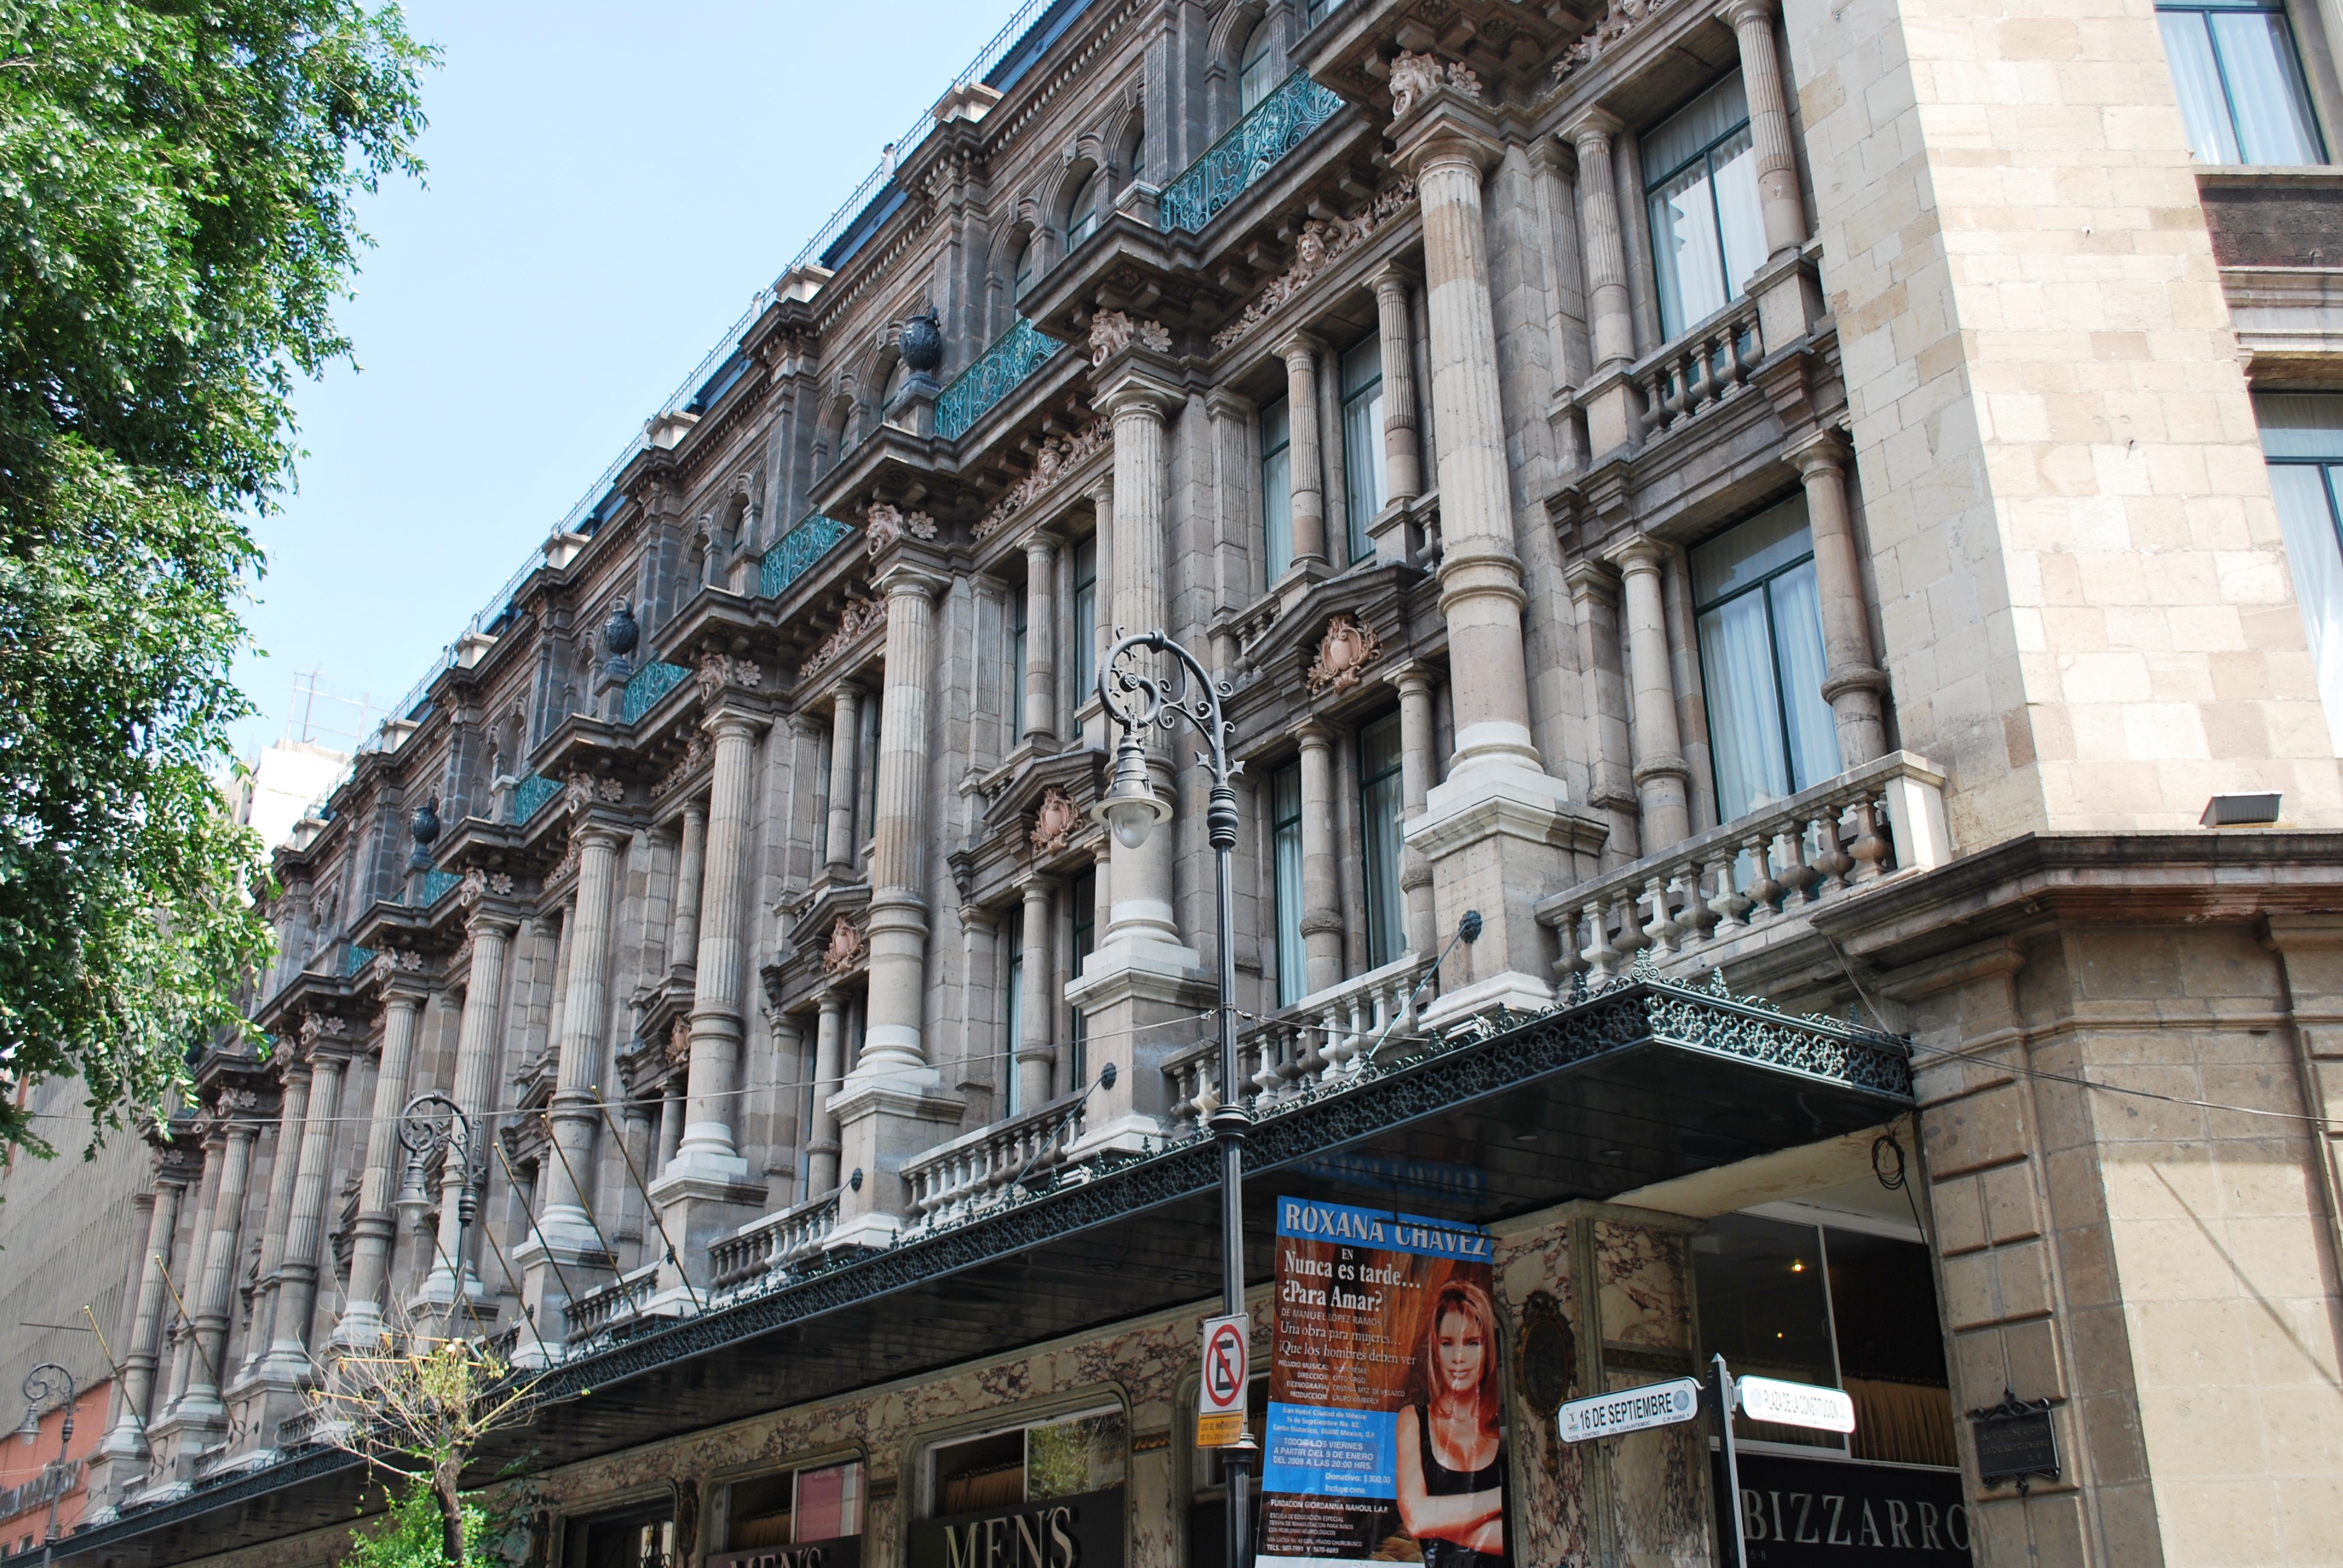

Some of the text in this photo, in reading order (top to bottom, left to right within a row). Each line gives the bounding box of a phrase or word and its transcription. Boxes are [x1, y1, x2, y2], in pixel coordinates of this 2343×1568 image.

[1285, 1203, 1487, 1256] ROXANA CHAVEZ
[1342, 1248, 1353, 1260] EN
[1285, 1250, 1420, 1289] Nunca es tarde...
[1283, 1279, 1383, 1312] ¿Para Amar?
[1281, 1308, 1381, 1327] DE MANUEL LOPEZ RAMOS
[1280, 1321, 1401, 1345] Una obra para mujeres...
[1279, 1341, 1417, 1365] ¡Que los hombres deben ver
[1312, 1409, 1334, 1417] Ciudad
[1579, 1409, 1590, 1429] 16
[1593, 1406, 1606, 1428] DE
[1608, 1393, 1673, 1424] SEPTIEMBRE
[1764, 1390, 1838, 1419] PLAZA DE LA CONSTITUCION
[1302, 1418, 1338, 1426] Septiembre
[1982, 1424, 2048, 1442] AVENIDA
[1284, 1437, 1309, 1446] TODOS
[1329, 1442, 1363, 1450] VIERNES
[1308, 1449, 1324, 1458] DEL
[1325, 1473, 1362, 1482] Donativo:
[1325, 1485, 1348, 1494] Incluye
[1305, 1501, 1344, 1511] GIORDANNA
[1345, 1503, 1372, 1512] NAHOUL
[1739, 1488, 1971, 1551] BIZZARRO
